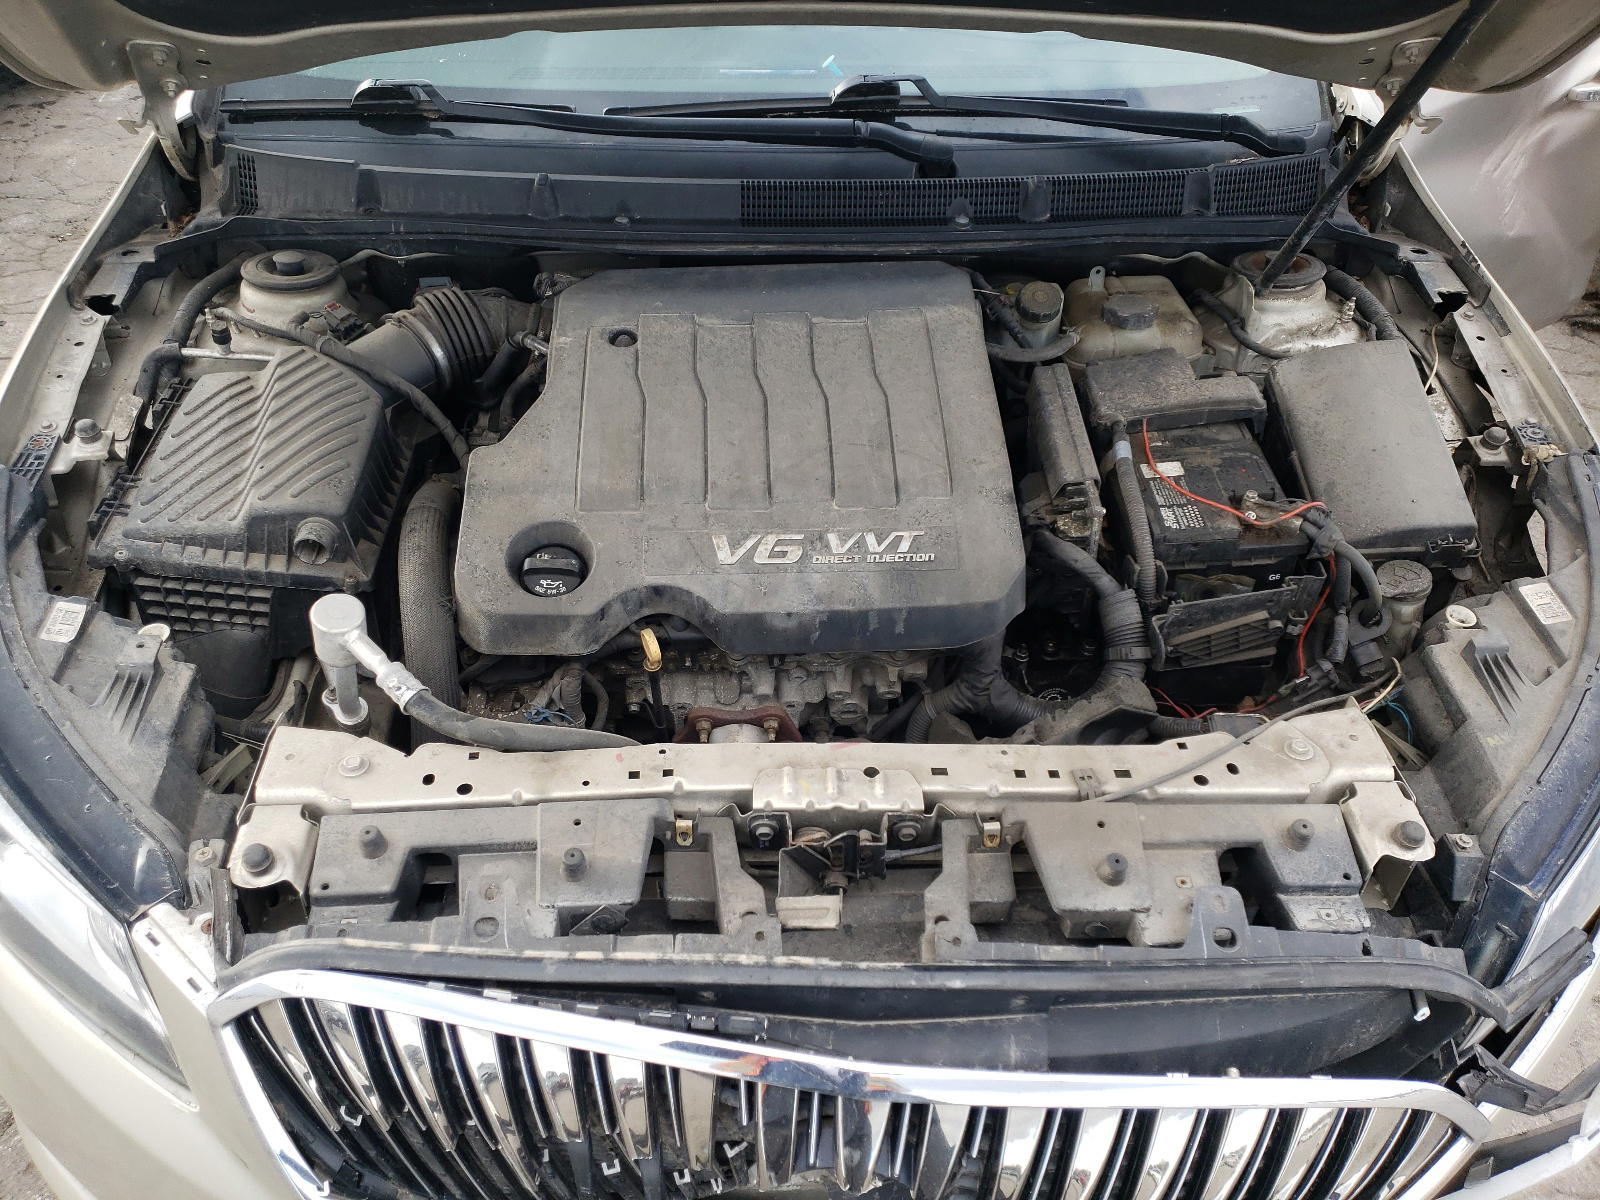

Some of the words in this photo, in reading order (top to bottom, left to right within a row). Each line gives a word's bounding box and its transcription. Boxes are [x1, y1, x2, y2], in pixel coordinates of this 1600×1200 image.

[711, 533, 805, 565] V6
[827, 530, 925, 554] VVT
[812, 553, 862, 564] DIRECT
[866, 552, 935, 563] INJECTION
